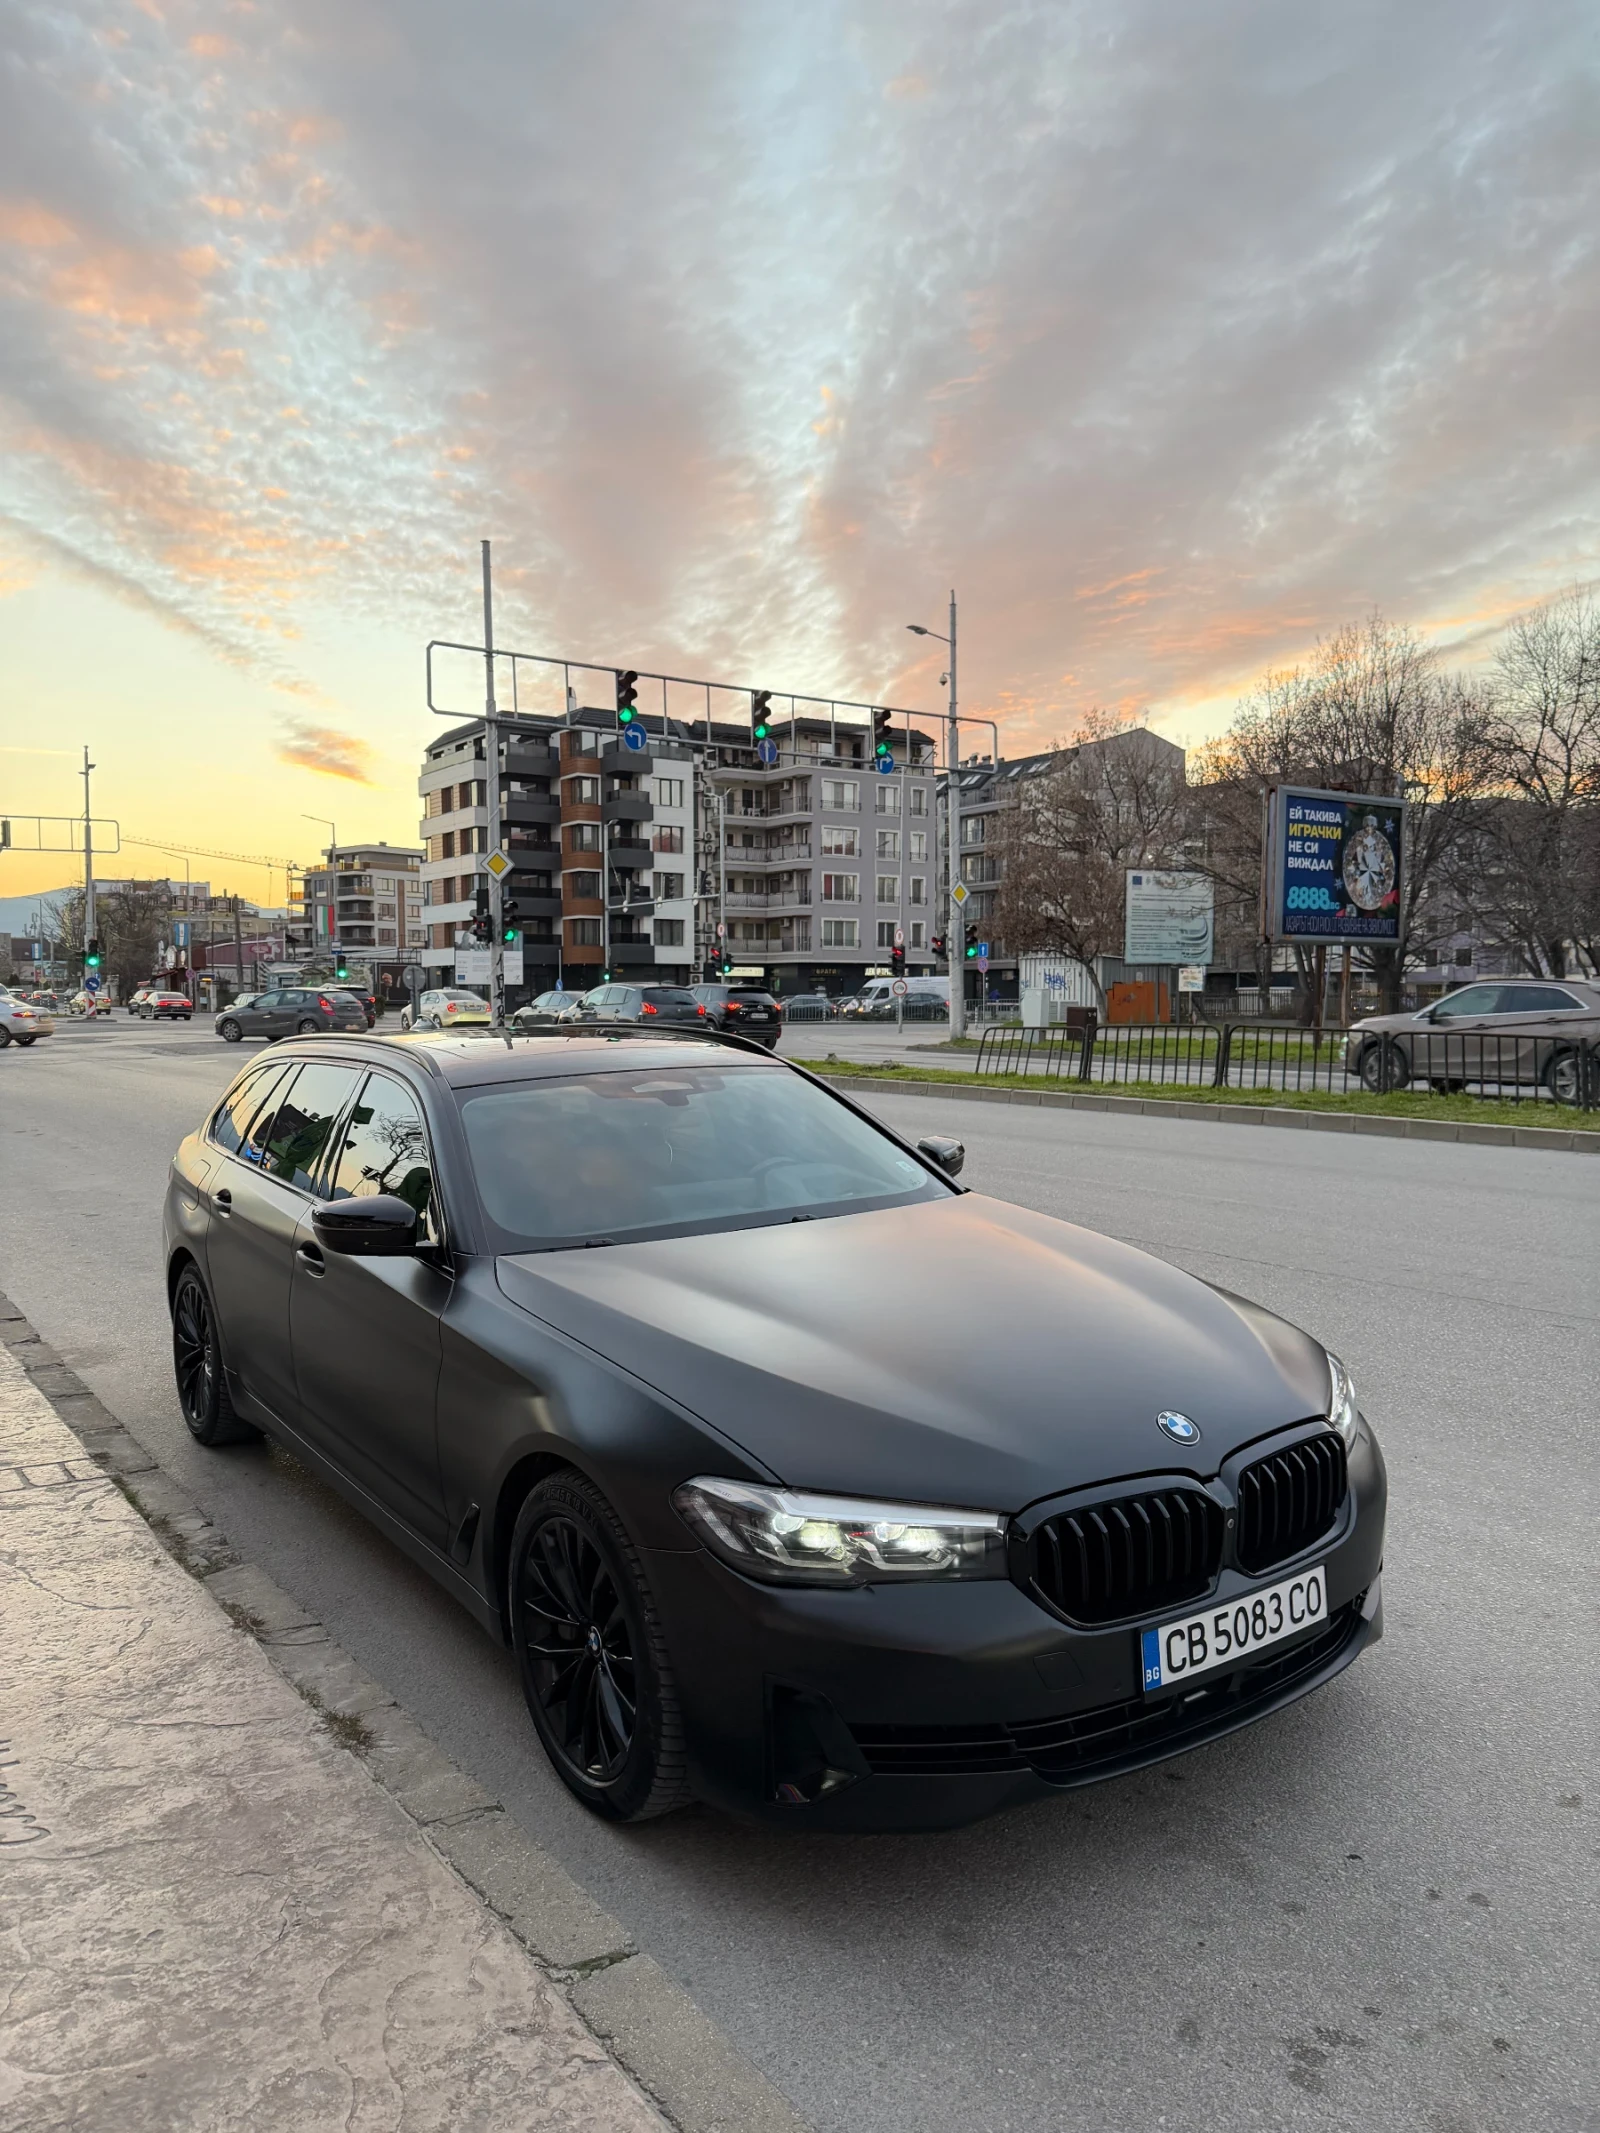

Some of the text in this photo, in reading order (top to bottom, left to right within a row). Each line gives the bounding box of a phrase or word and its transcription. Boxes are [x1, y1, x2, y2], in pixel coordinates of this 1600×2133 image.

[1289, 806, 1342, 823] ЕЙ ТАКИВА
[1289, 823, 1342, 840] ИГРАЧКИ
[1288, 840, 1319, 854] НЕ СИ
[1287, 857, 1334, 871] ВИЖДАЛ
[1213, 1592, 1284, 1656] 5083
[1145, 1666, 1160, 1683] BG
